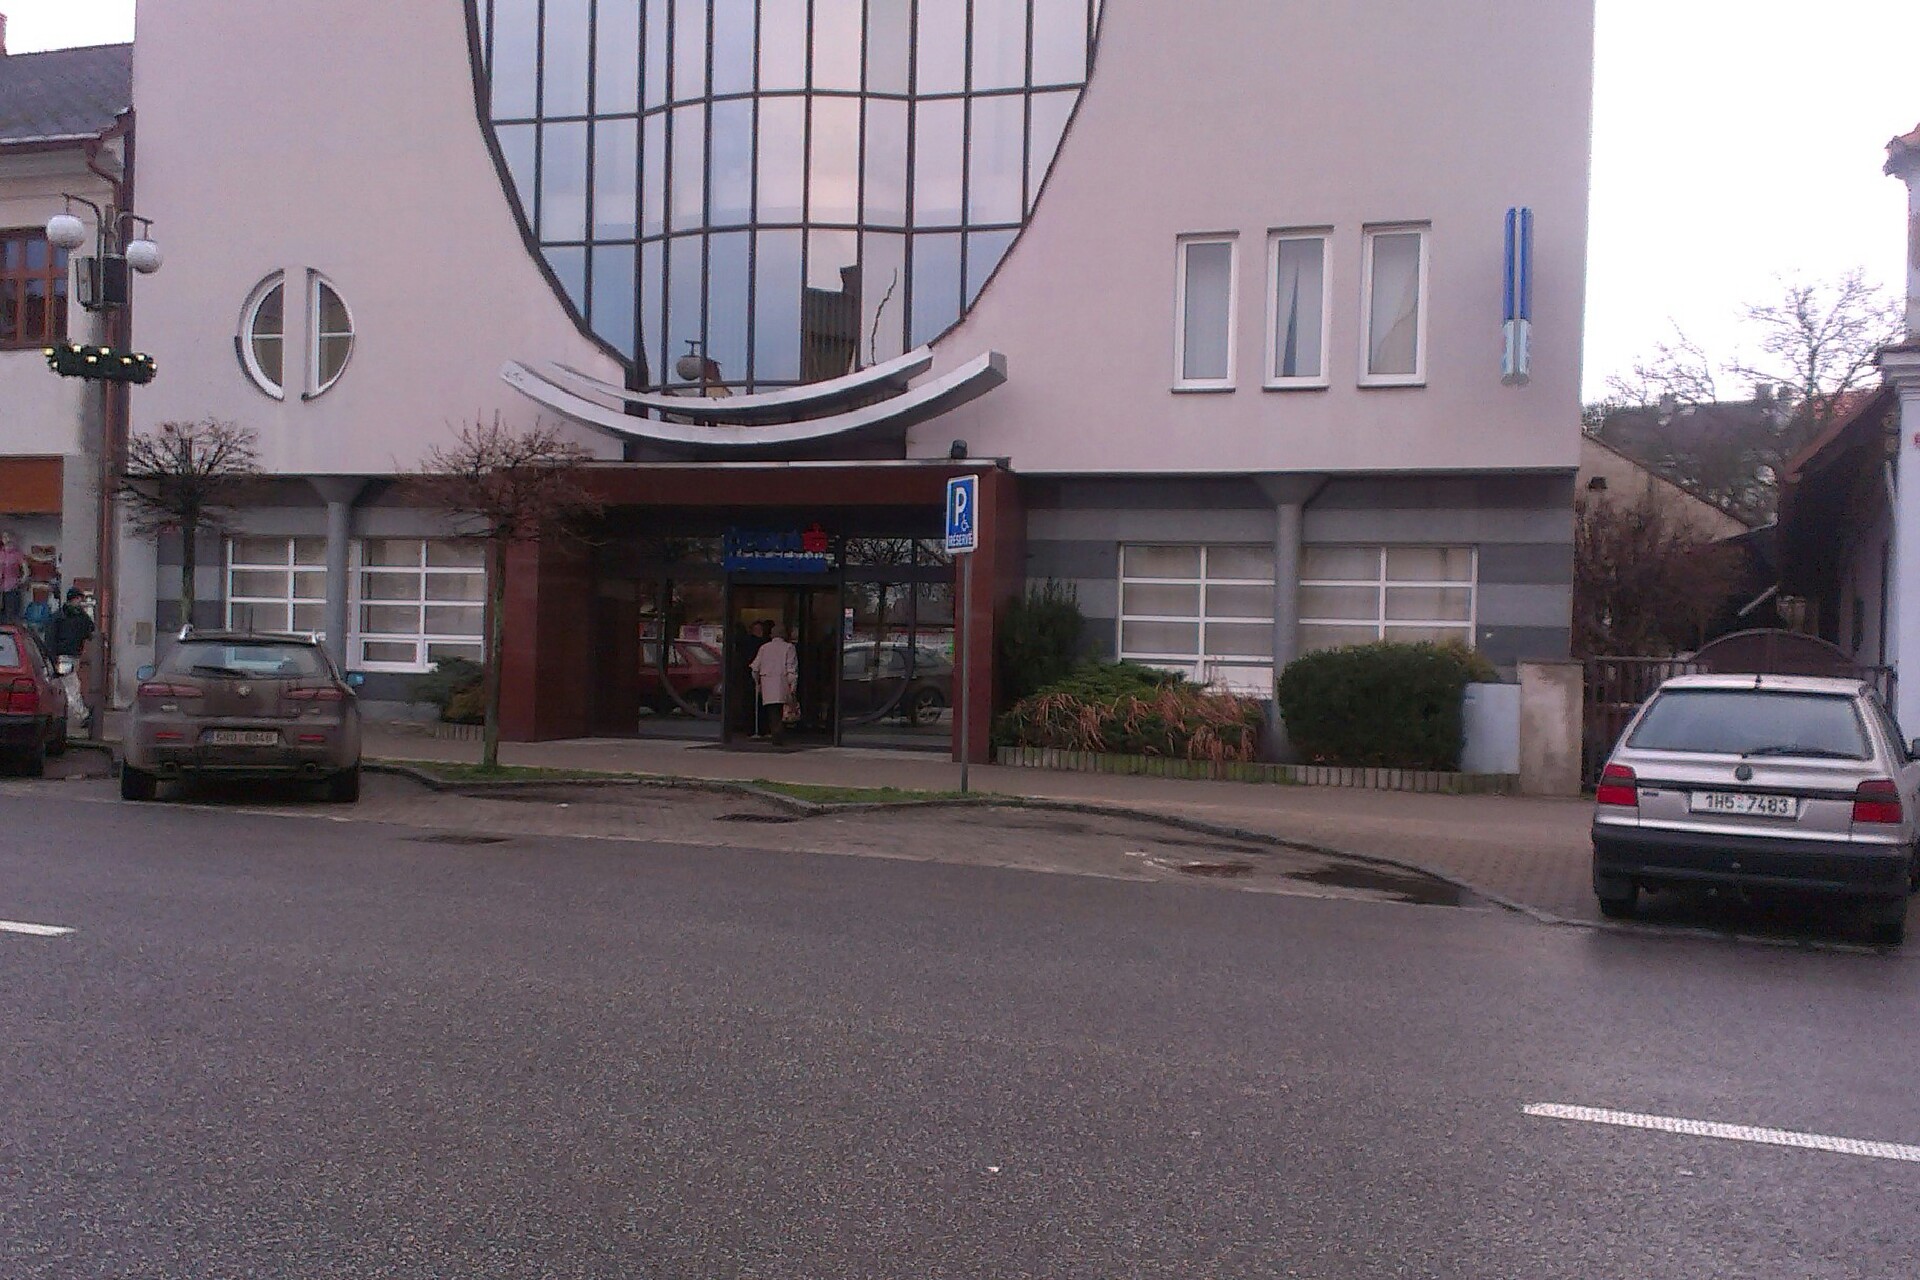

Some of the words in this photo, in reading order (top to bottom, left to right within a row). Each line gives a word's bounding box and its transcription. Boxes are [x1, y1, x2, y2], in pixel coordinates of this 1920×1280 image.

[954, 486, 967, 527] P
[1706, 794, 1734, 809] 1H5
[1747, 794, 1788, 814] 7483
